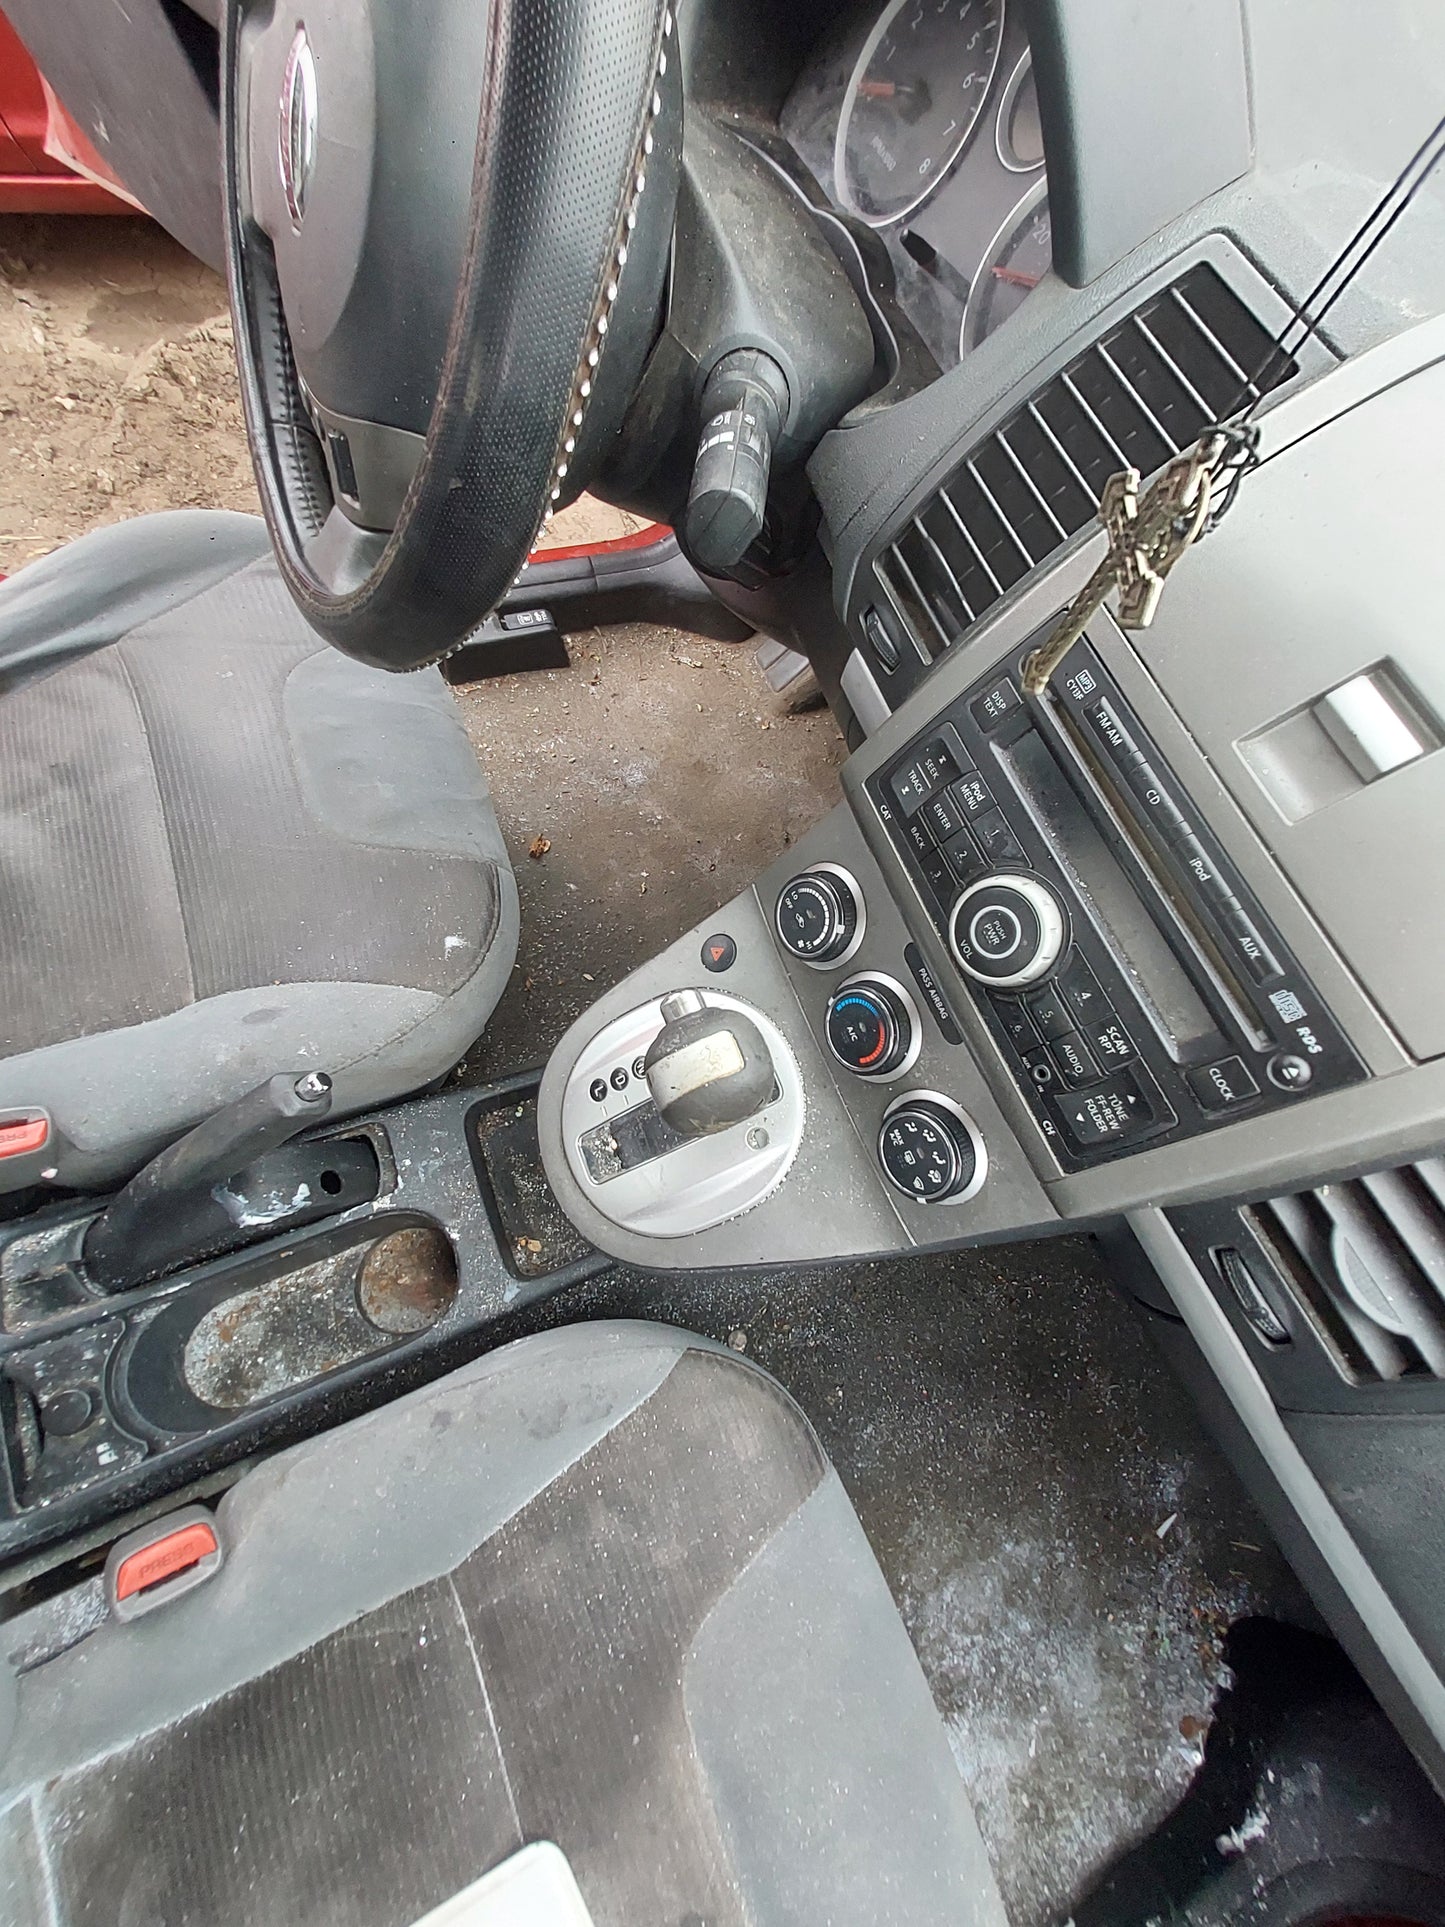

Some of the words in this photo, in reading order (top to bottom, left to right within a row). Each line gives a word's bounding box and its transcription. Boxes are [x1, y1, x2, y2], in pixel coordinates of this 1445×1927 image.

[966, 31, 980, 51] 5
[962, 72, 976, 89] 6
[943, 119, 957, 136] 7
[918, 158, 931, 174] 8
[983, 699, 999, 718] TEXT
[990, 690, 1008, 710] DISP
[923, 758, 940, 781] SEEK
[907, 769, 925, 796] TRACK
[969, 780, 987, 803] iPod
[960, 783, 979, 811] MENU
[1145, 789, 1161, 806] CD
[879, 804, 893, 822] CAT
[932, 803, 952, 831] ENTER
[910, 826, 926, 850] BACK
[1188, 856, 1212, 883] iPod
[983, 922, 1001, 946] PWR
[992, 918, 1008, 941] PUSH
[959, 938, 974, 961] VOL
[1238, 936, 1262, 961] AUX
[918, 967, 933, 988] PASS
[928, 989, 949, 1020] AIRBAG
[846, 1026, 859, 1042] A/C
[1097, 1035, 1116, 1056] RPT
[1105, 1025, 1130, 1056] SCAN
[1062, 1043, 1084, 1075] AUDIO
[594, 1085, 604, 1097] L
[614, 1074, 626, 1085] D
[1208, 1067, 1237, 1102] CLOCK
[1084, 1098, 1108, 1133] FOLDER
[1107, 1092, 1130, 1122] TUNE
[1041, 1119, 1057, 1137] CH
